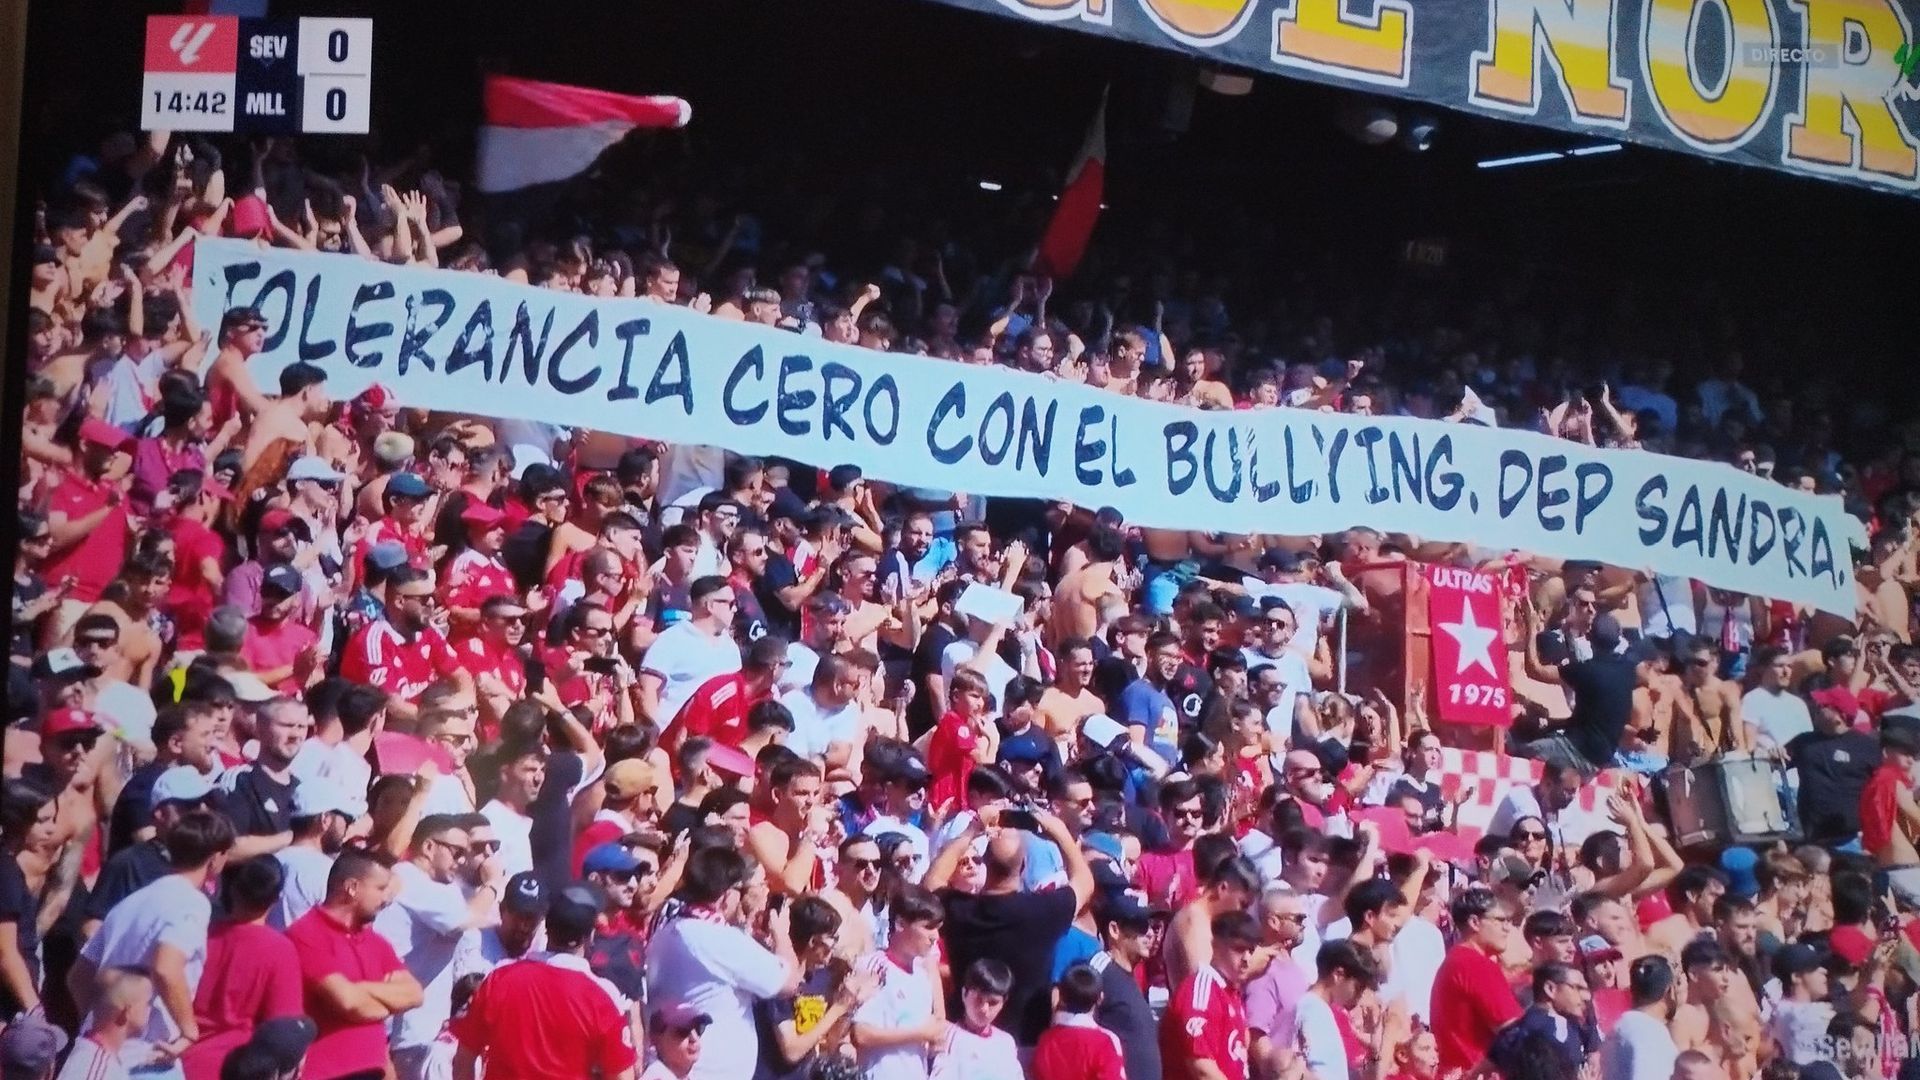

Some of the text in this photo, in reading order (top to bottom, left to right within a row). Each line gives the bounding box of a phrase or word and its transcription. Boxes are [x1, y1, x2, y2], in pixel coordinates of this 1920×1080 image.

[250, 29, 349, 63] SEV 0
[1751, 48, 1826, 63] DIRECTO
[153, 90, 227, 114] 14:42
[246, 87, 347, 121] MLL 0
[218, 260, 695, 417] TOLERANCIA
[722, 343, 900, 447] CERO
[926, 381, 1058, 478] CON
[1074, 405, 1137, 488] EL
[1498, 448, 1614, 536] DEP
[1433, 567, 1493, 595] ULTRAS
[1449, 683, 1506, 709] 1975
